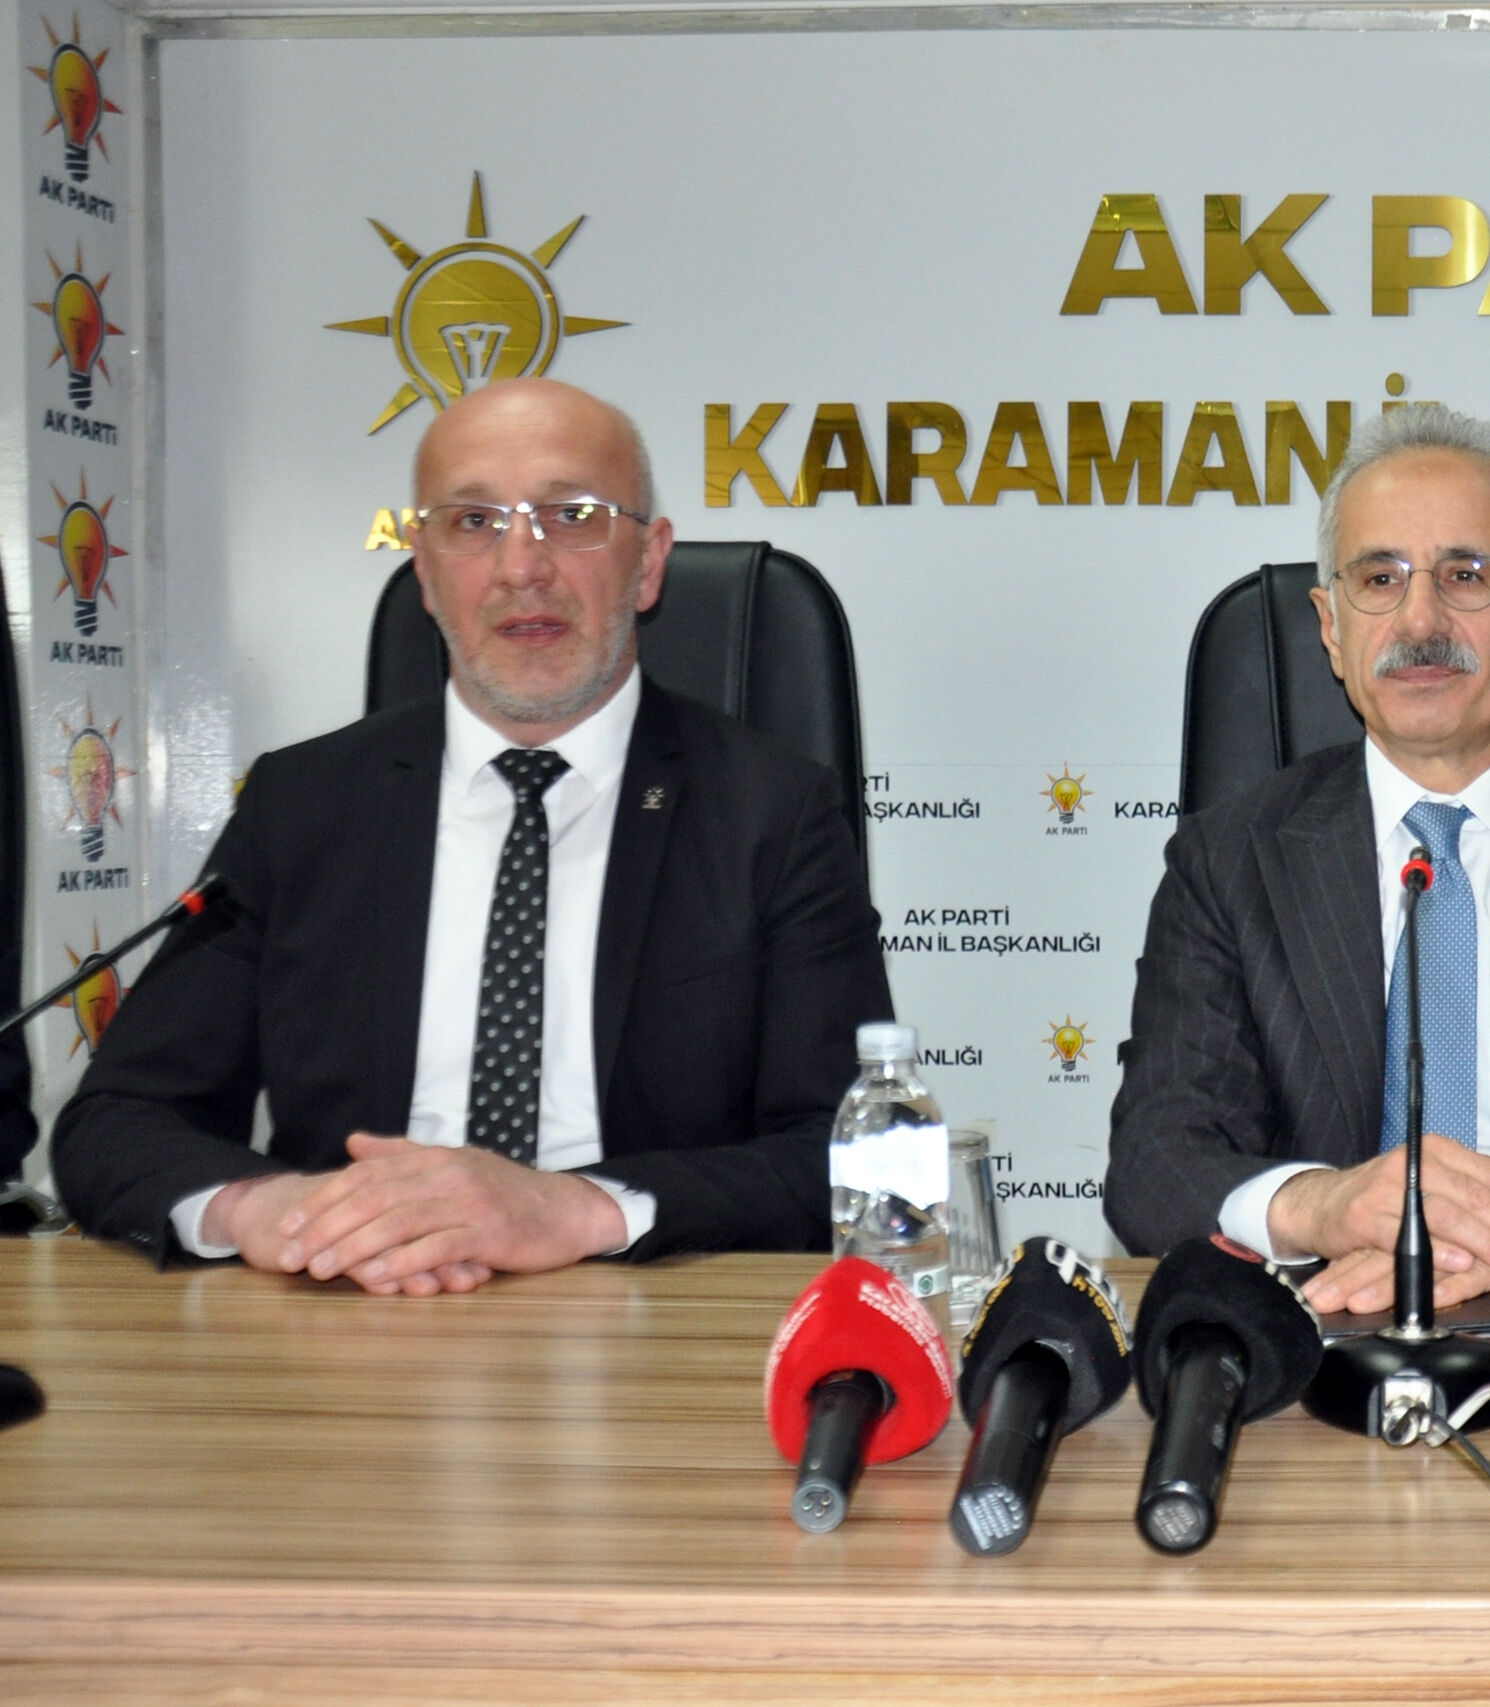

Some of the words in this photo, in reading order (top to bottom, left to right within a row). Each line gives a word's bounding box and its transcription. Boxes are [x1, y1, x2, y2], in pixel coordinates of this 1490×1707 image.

[40, 176, 64, 204] AK
[1059, 193, 1333, 316] AK
[43, 409, 68, 434] AK
[704, 400, 1352, 508] KARAMAN
[50, 641, 75, 664] AK
[864, 798, 980, 823] AŞKANLIĞI
[1114, 801, 1180, 818] KARA
[1045, 826, 1059, 836] AK
[57, 870, 81, 893] AK
[904, 908, 936, 926] AK
[941, 905, 1010, 926] PARTİ
[938, 932, 957, 952] İL
[961, 932, 1101, 957] BAŞKANLIĞI
[1048, 1074, 1061, 1083] AK
[995, 1178, 1103, 1203] ŞKANLIĞI
